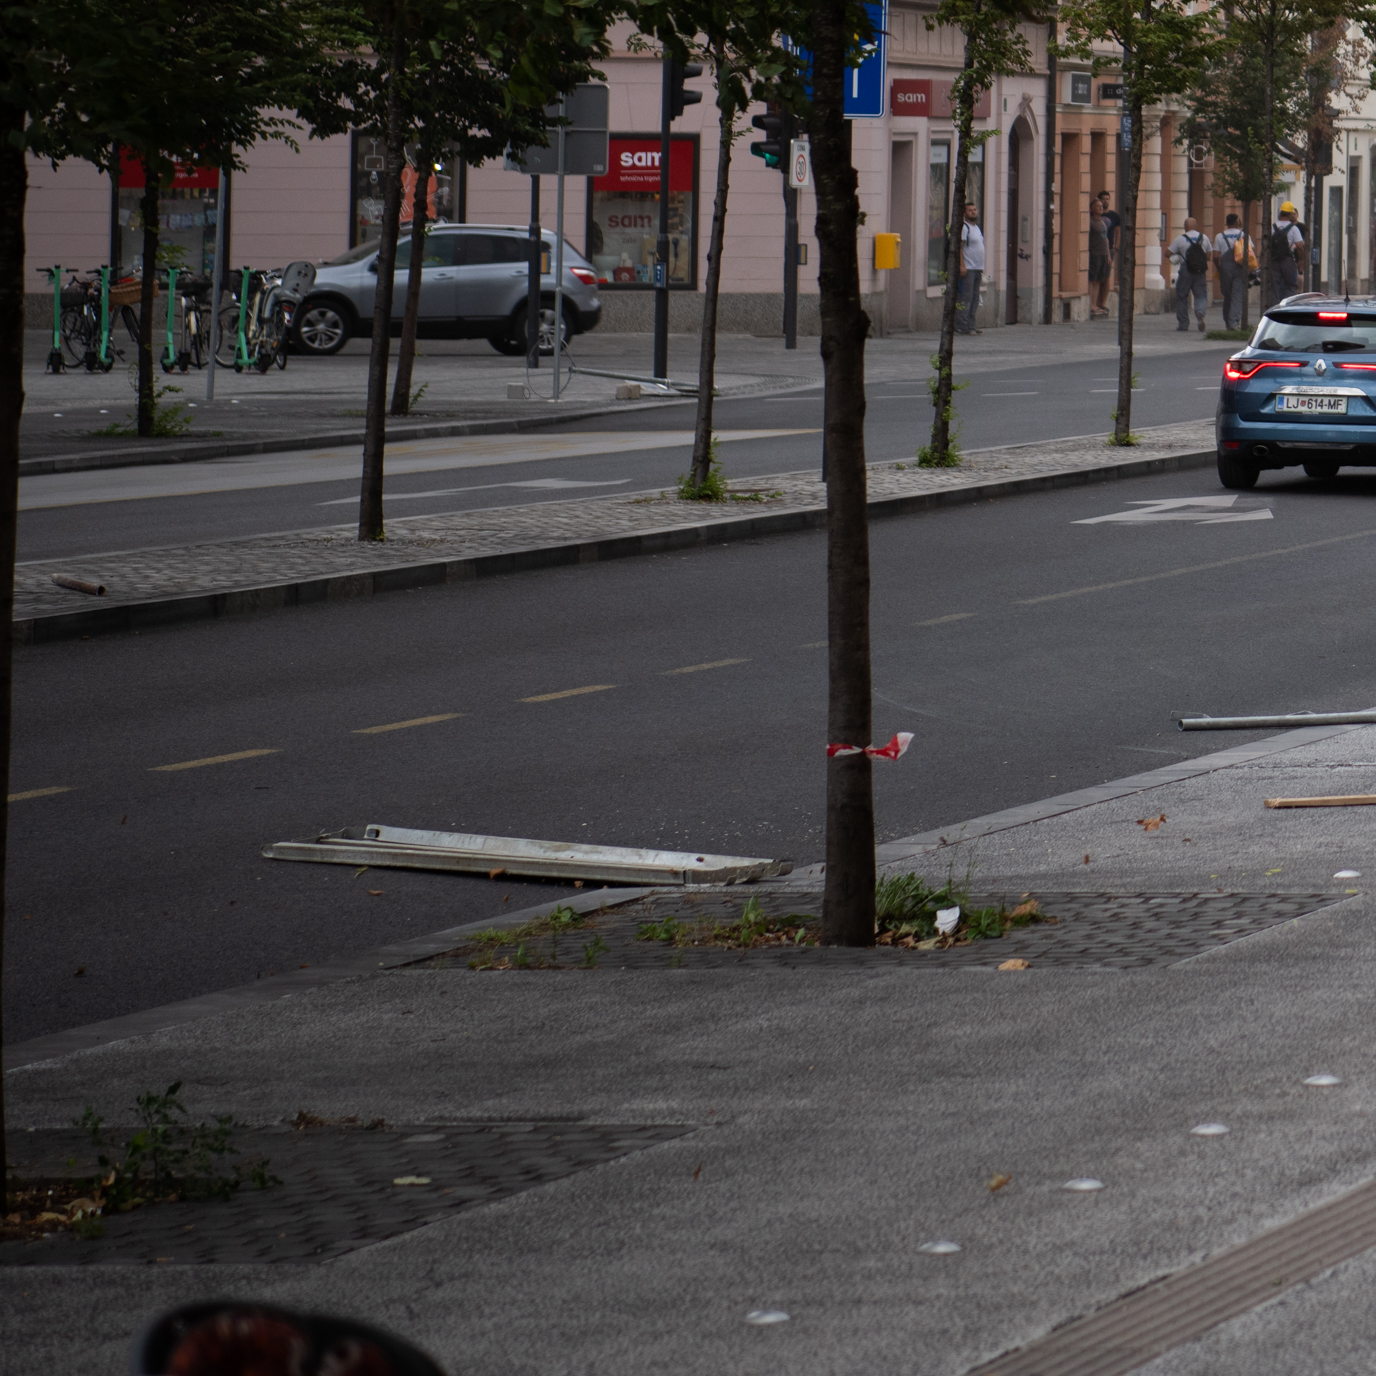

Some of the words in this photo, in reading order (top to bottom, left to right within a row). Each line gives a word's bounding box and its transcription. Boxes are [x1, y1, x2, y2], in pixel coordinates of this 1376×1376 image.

[897, 91, 926, 103] sam
[620, 151, 662, 167] sam
[644, 175, 661, 183] trgovi
[608, 214, 652, 228] sam
[1286, 398, 1299, 409] LJ
